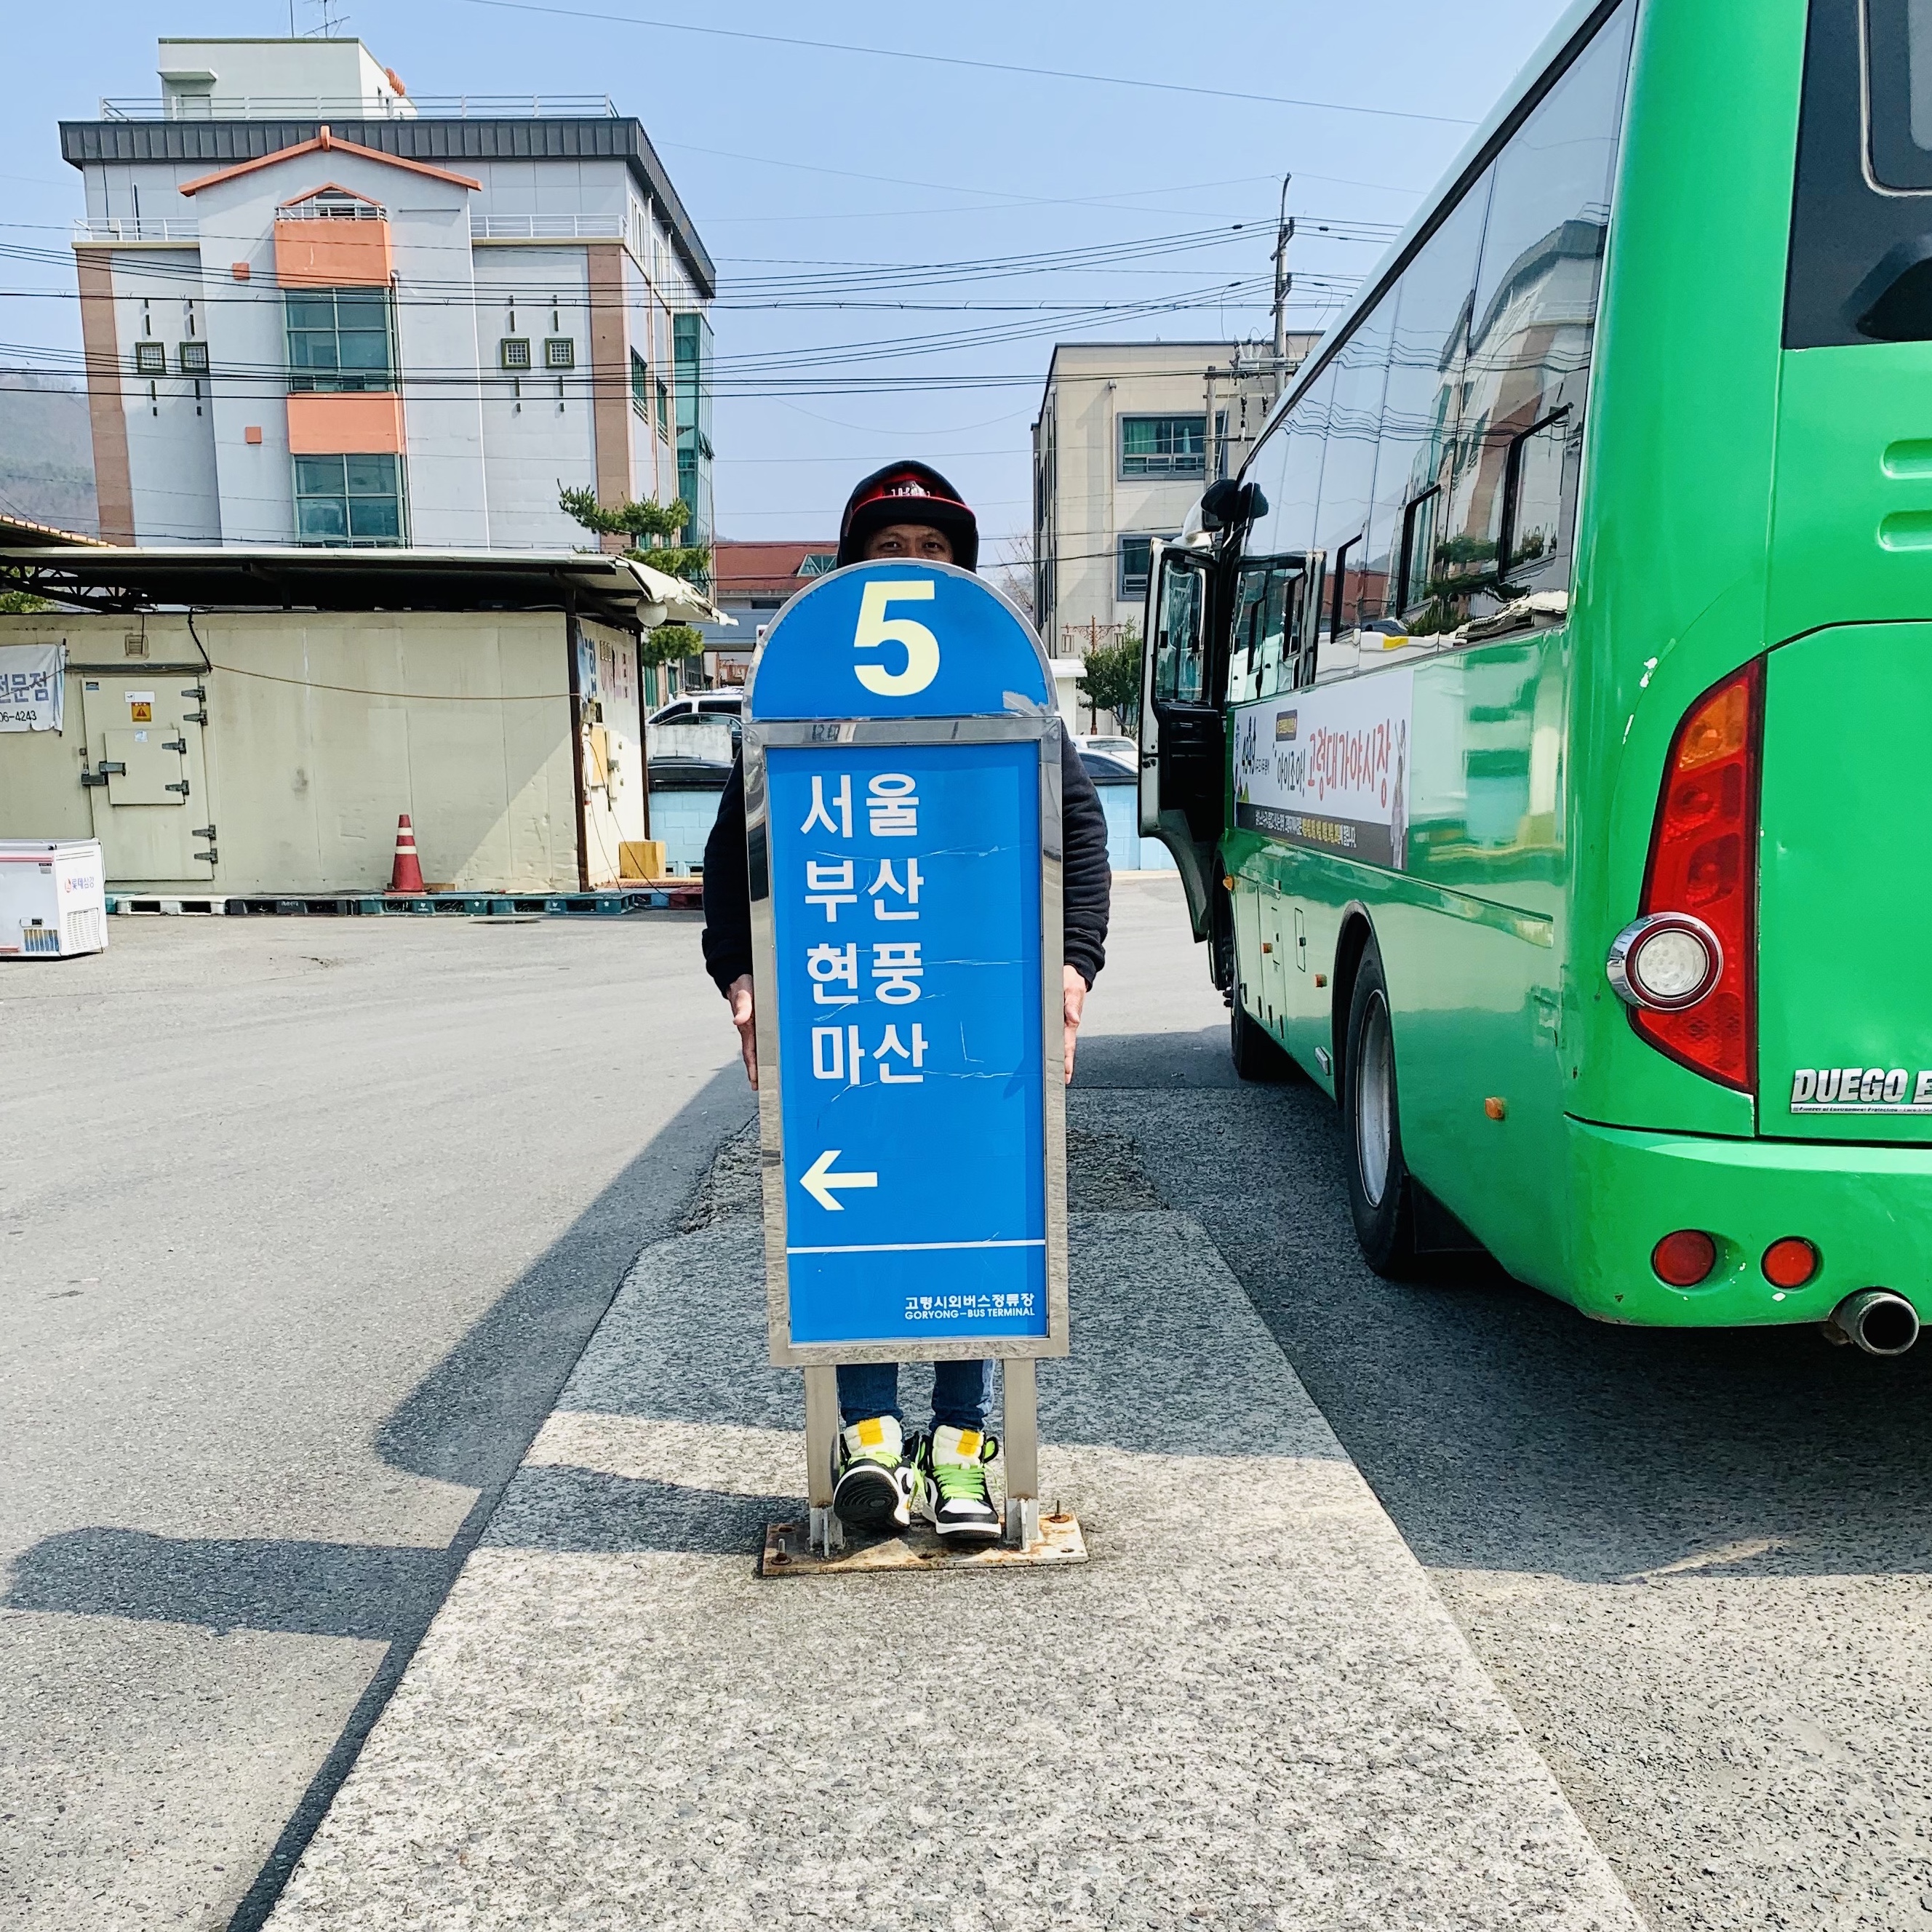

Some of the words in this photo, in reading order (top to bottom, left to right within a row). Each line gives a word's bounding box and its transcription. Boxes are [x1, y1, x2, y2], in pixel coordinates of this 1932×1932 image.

[853, 580, 941, 696] 5
[800, 773, 919, 838] 서울
[805, 858, 925, 922] 부산
[807, 943, 924, 1005] 현풍
[812, 1023, 928, 1085] 마산
[1792, 1068, 1909, 1103] DUEGO
[904, 1309, 986, 1320] GORYONG-BUS
[987, 1306, 1036, 1318] TERMINAL
[905, 1293, 1036, 1310] 고령시외버스정류장
